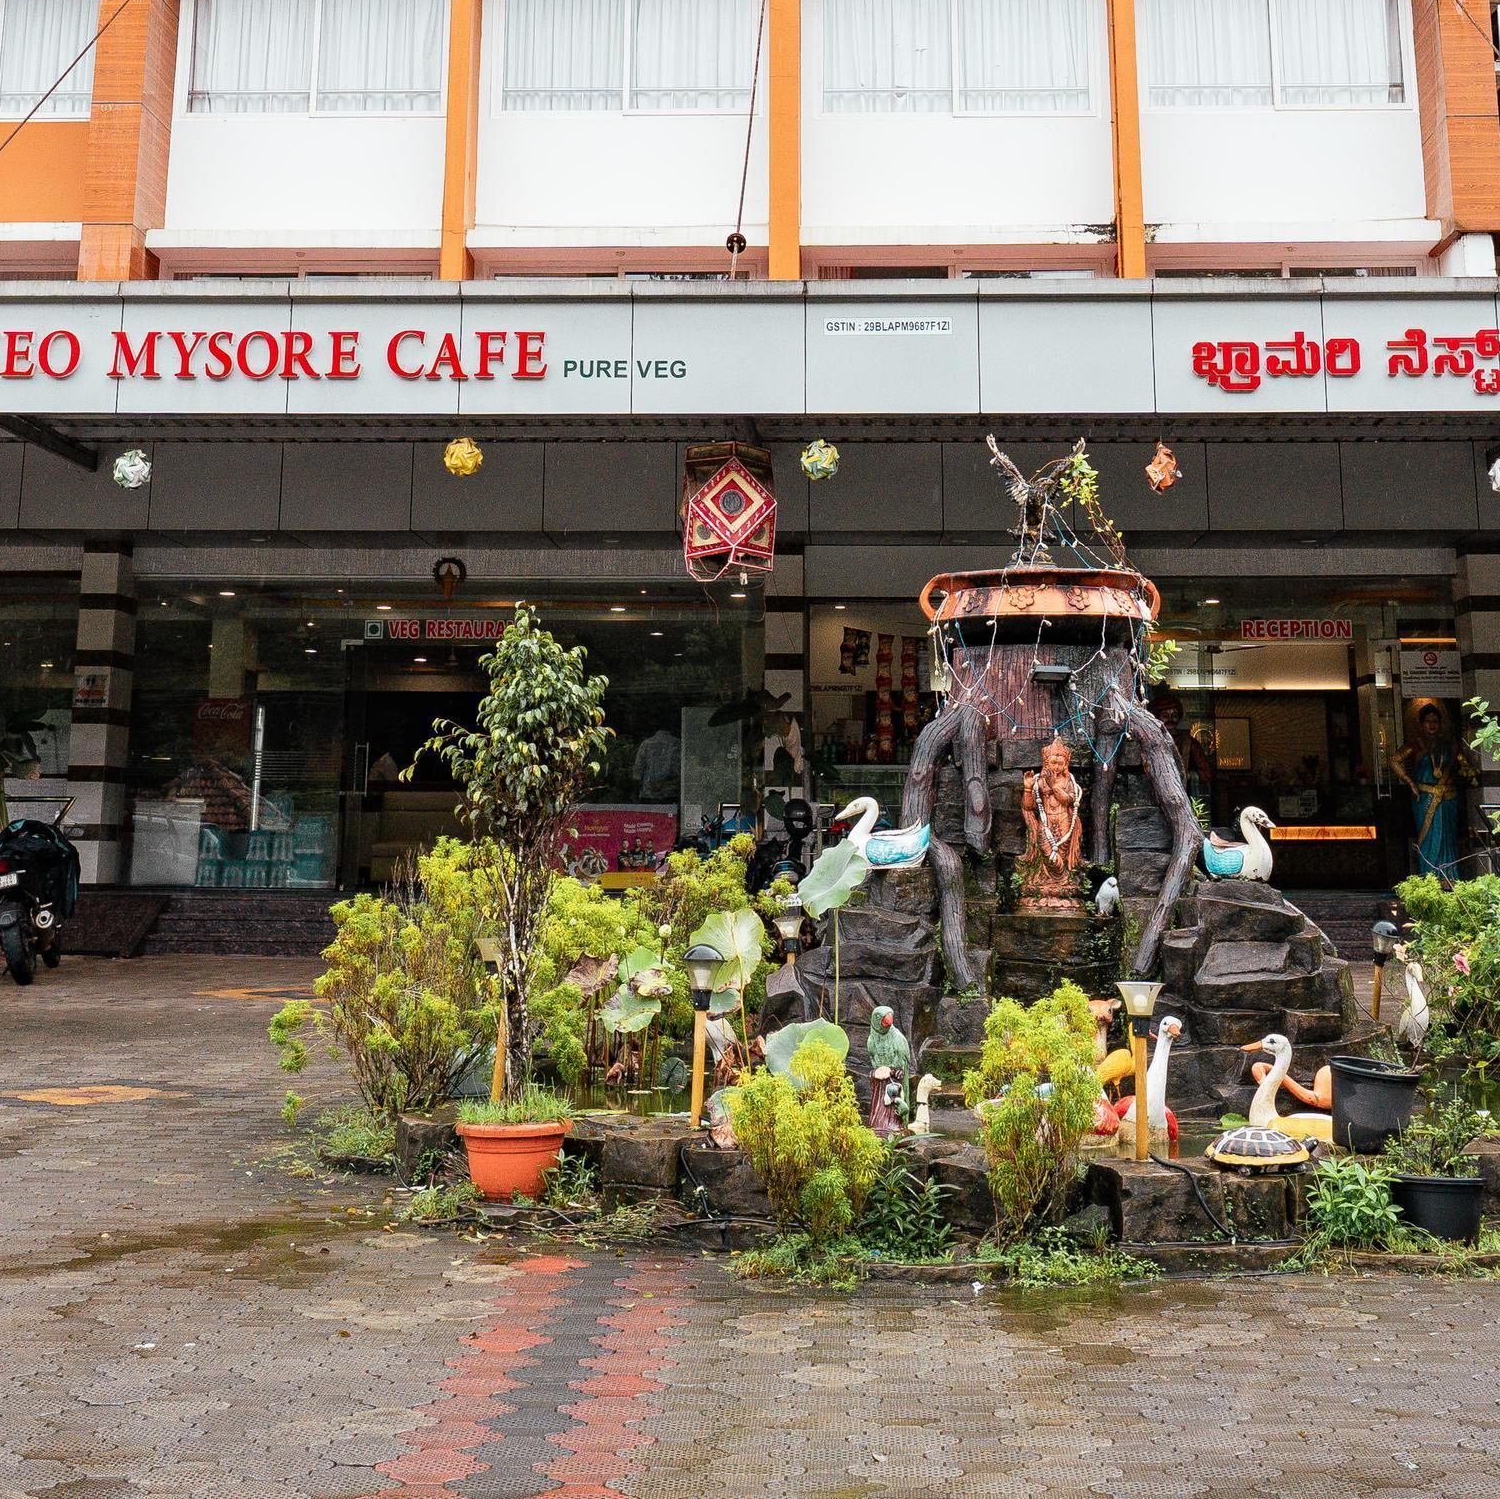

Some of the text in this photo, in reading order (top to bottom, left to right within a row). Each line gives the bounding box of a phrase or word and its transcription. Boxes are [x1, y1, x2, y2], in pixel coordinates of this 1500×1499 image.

[826, 322, 856, 332] GSTIN
[109, 331, 363, 380] MYSORE
[387, 330, 549, 380] CAFE
[1192, 332, 1362, 392] ಭ್ರಾಮರಿ
[563, 361, 687, 379] PURE VEG
[387, 619, 514, 639] VEG RESTAURA
[1241, 619, 1353, 638] RECEPTION
